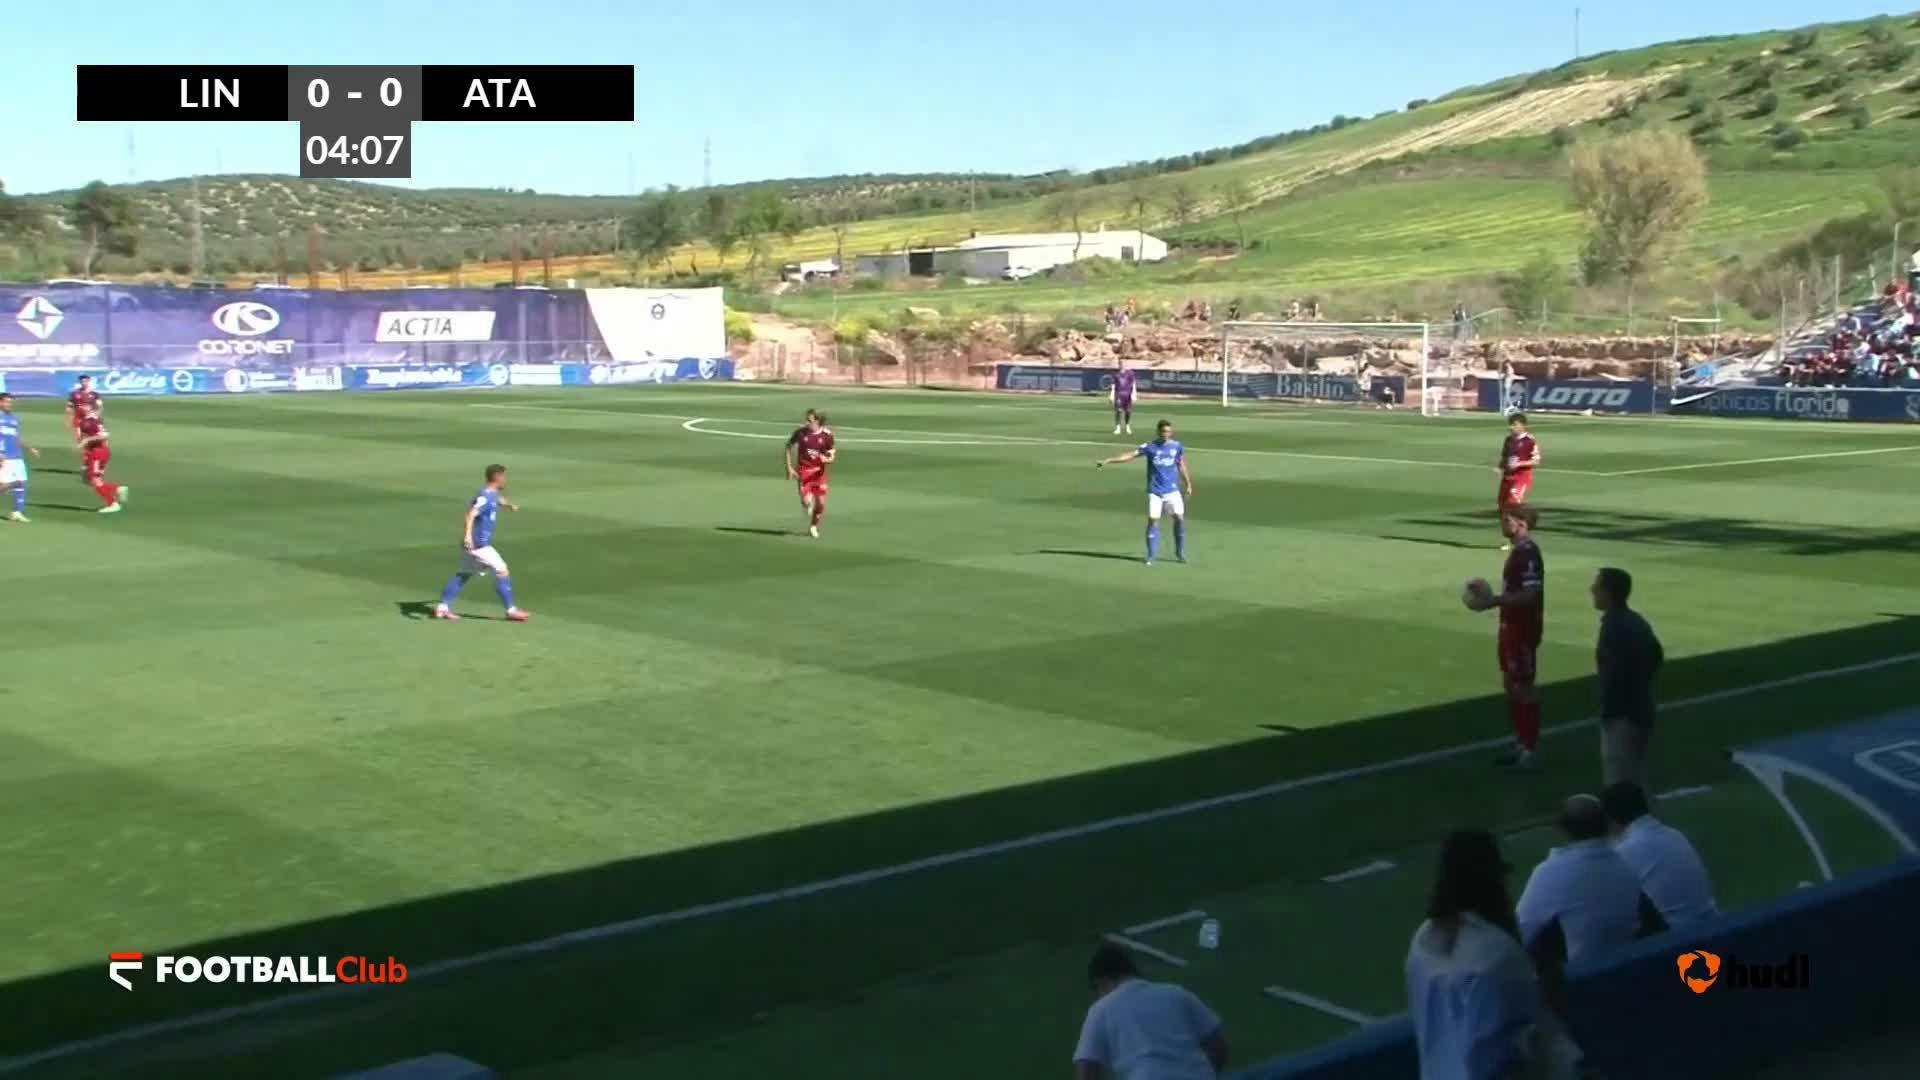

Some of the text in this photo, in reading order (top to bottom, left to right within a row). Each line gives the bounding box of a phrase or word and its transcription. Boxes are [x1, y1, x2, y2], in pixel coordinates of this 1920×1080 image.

[387, 317, 453, 335] ACTIA
[199, 339, 295, 354] CORONET
[1532, 386, 1632, 405] LOTTO
